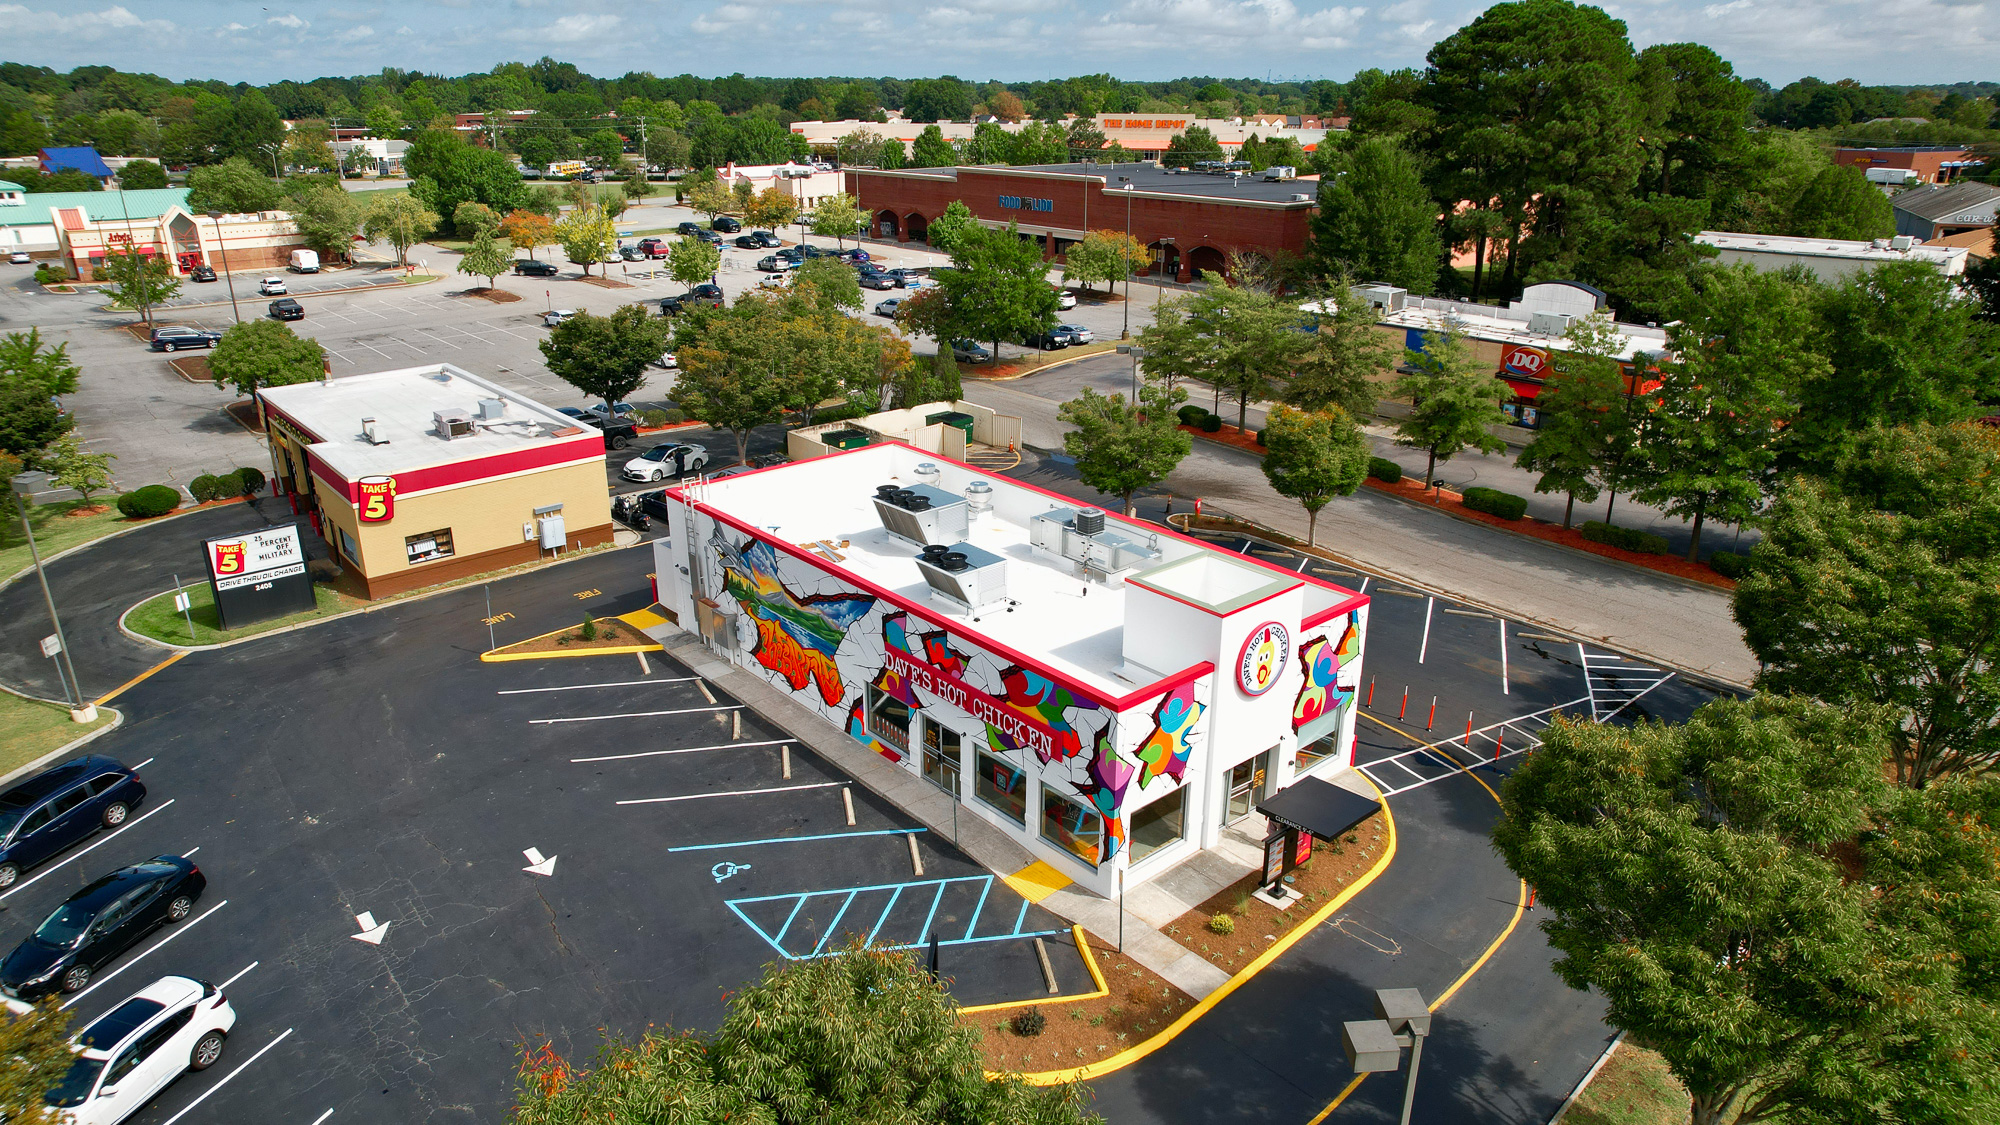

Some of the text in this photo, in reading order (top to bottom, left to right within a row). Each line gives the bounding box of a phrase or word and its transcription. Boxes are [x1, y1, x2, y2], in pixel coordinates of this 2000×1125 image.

[1104, 119, 1186, 128] THE HOME DEPOT
[998, 195, 1053, 212] FOOD LION
[1511, 352, 1540, 371] DQ
[361, 483, 388, 494] TAKE
[365, 495, 387, 519] 5
[217, 544, 240, 554] TAKE
[260, 535, 292, 548] PERCENT
[275, 542, 290, 551] OFF
[259, 549, 293, 561] MILITARY
[219, 554, 239, 573] 5
[220, 565, 303, 589] DRIVE THRU OIL CHANGE
[254, 581, 273, 592] 2405
[573, 588, 602, 600] FIRE
[481, 611, 516, 626] LANE
[1243, 626, 1287, 686] DAVE'S HOT CHICKEN
[885, 650, 932, 691] DAVE'S
[937, 677, 967, 710] HOT
[973, 698, 1053, 757] CHICKEN
[1275, 815, 1301, 831] CLEARANCE
